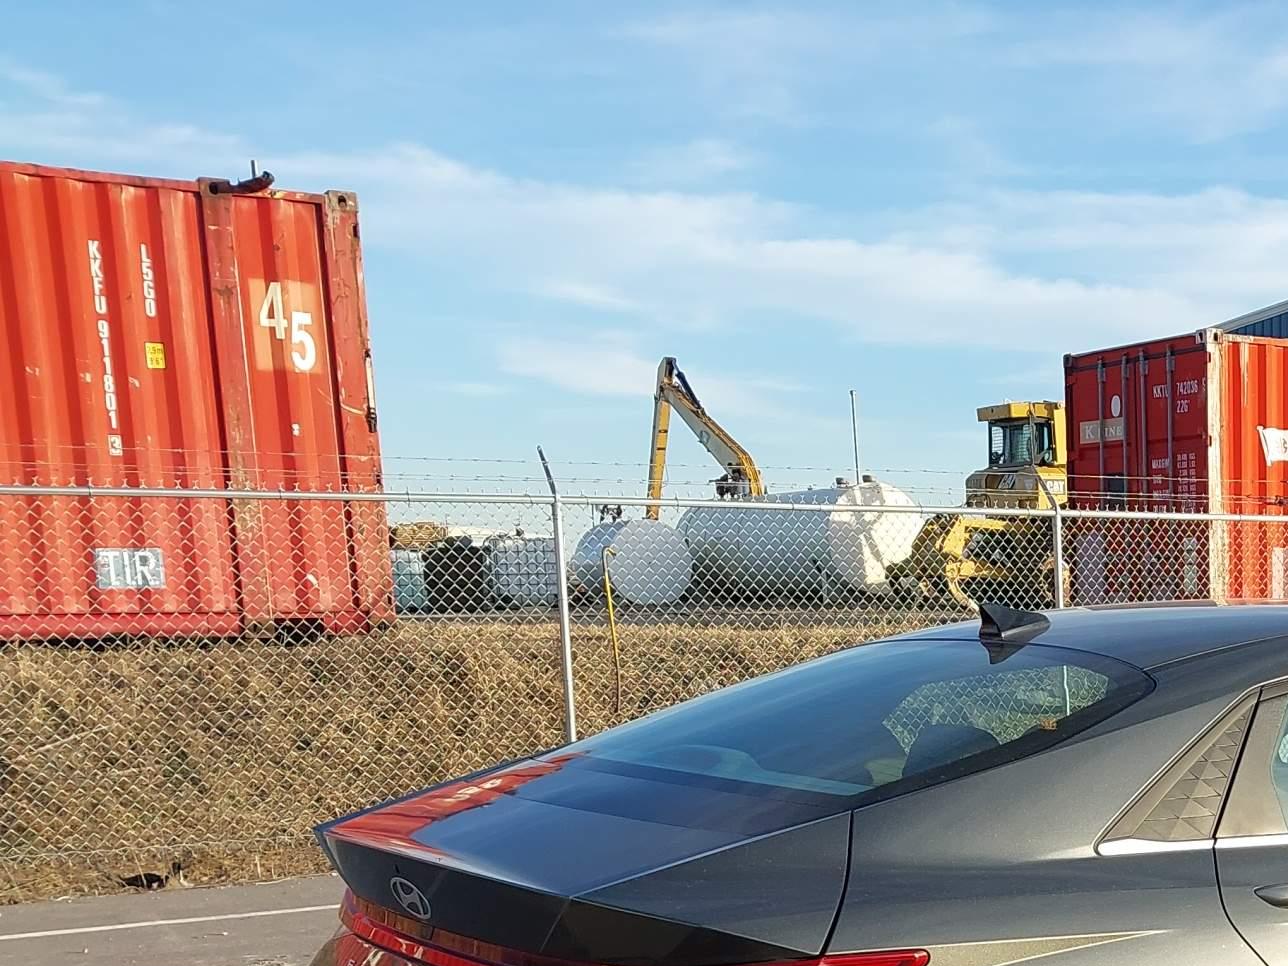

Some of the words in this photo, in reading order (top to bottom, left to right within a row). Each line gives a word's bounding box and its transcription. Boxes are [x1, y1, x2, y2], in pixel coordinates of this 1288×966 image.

[87, 239, 107, 315] KKFU
[97, 319, 117, 429] 911801
[99, 550, 161, 586] TIR
